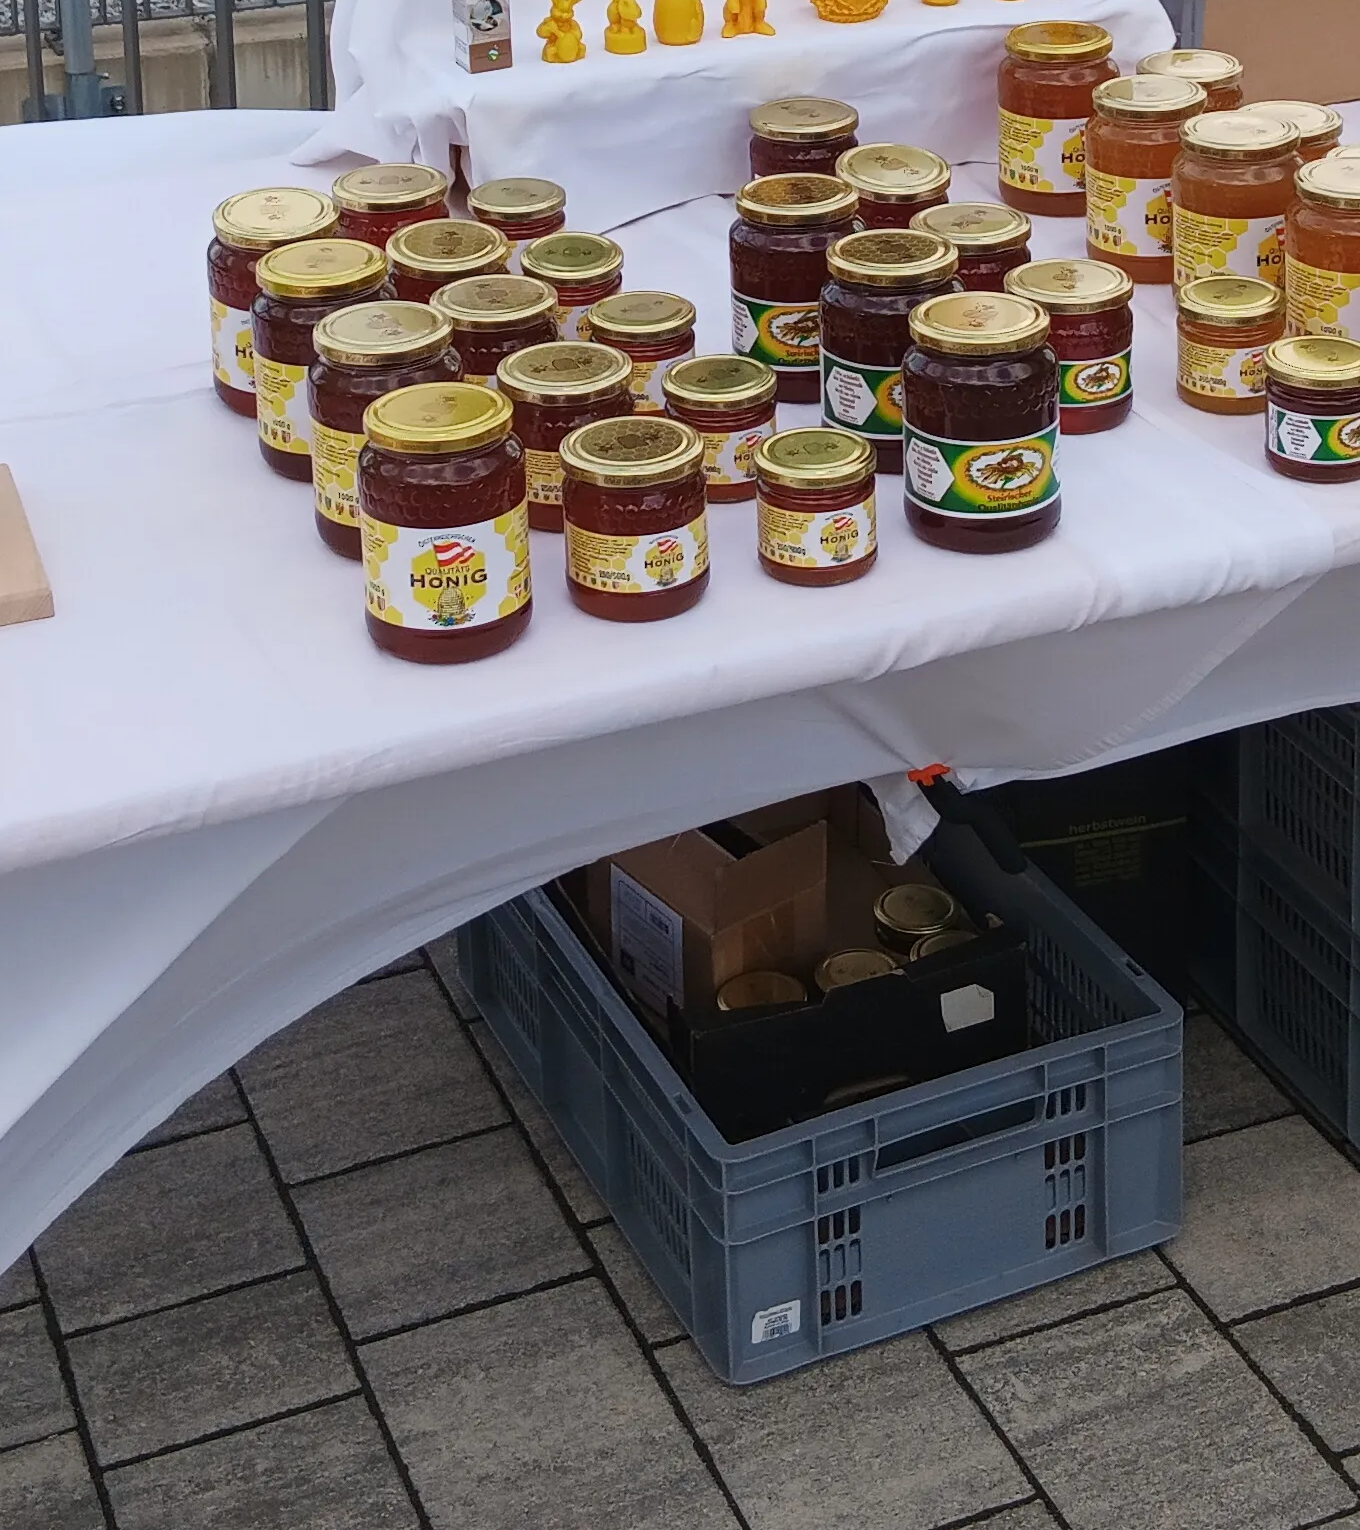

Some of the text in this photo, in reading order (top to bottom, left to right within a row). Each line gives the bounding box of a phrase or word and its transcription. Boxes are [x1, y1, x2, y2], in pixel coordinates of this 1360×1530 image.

[820, 530, 859, 545] HONIG
[645, 551, 685, 569] HONIG
[410, 568, 488, 589] HONIG
